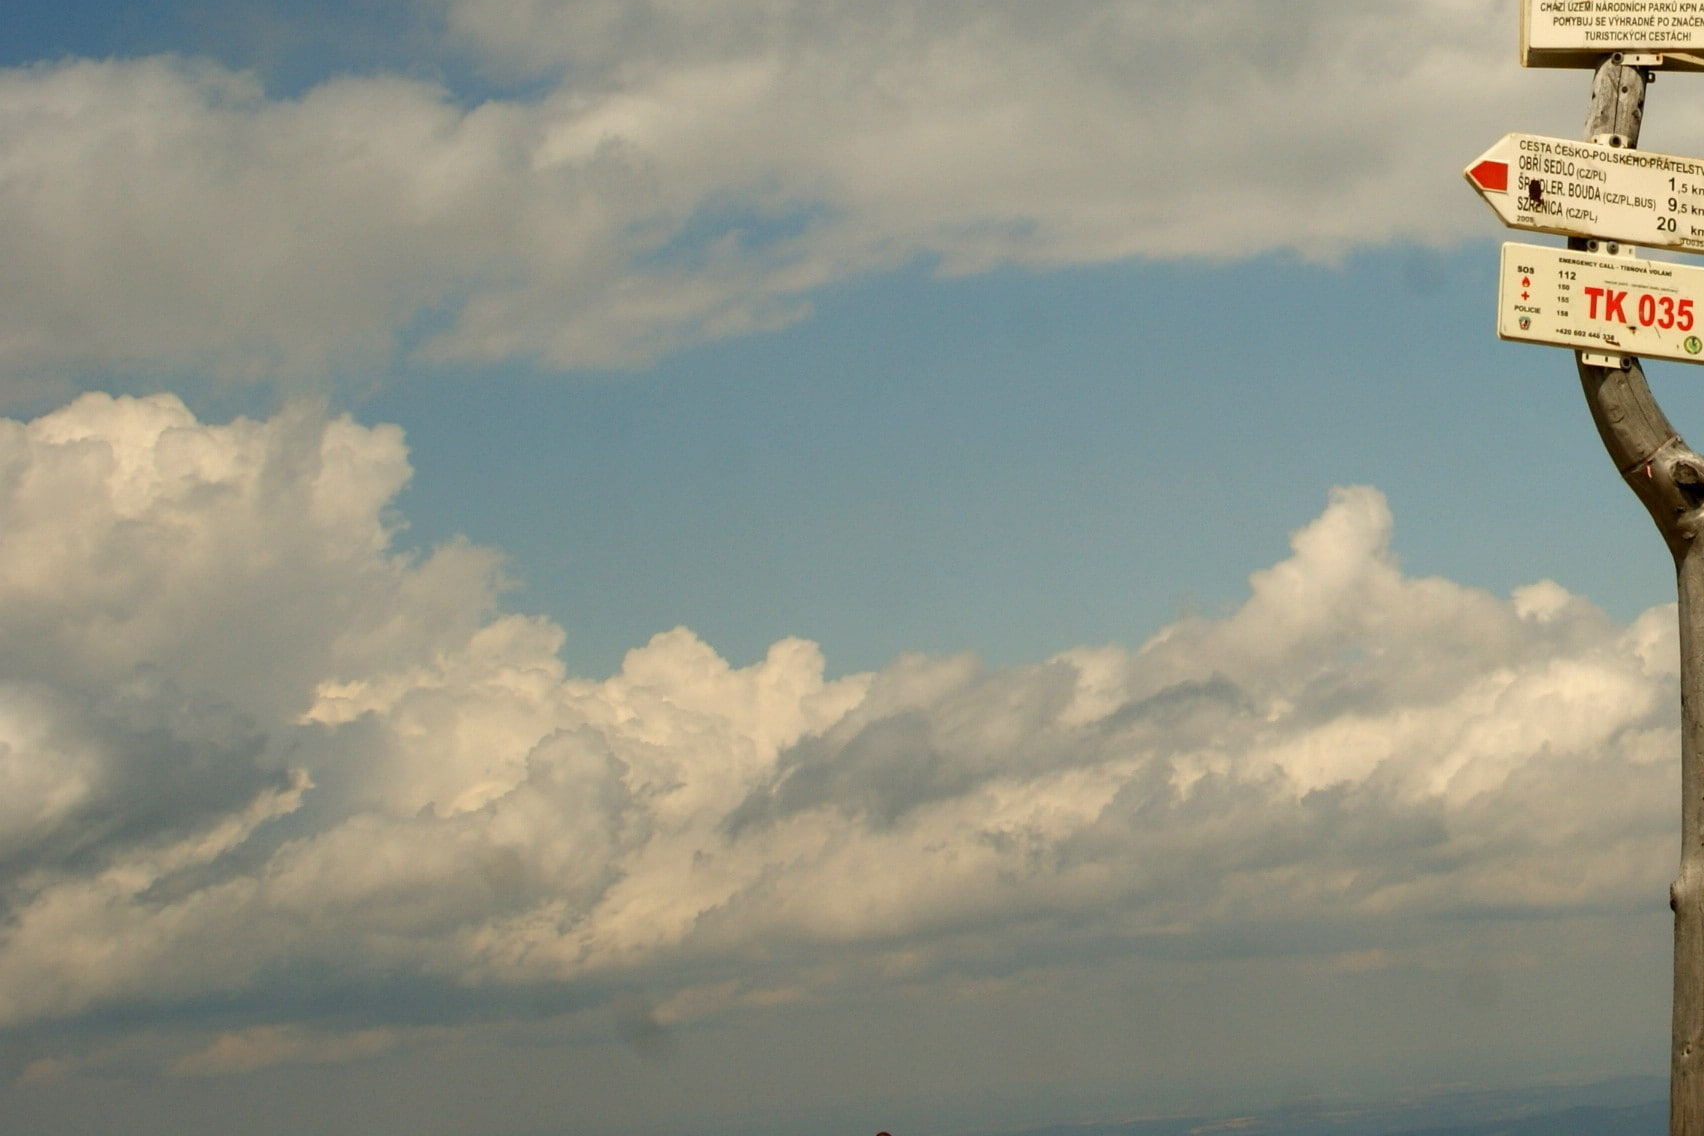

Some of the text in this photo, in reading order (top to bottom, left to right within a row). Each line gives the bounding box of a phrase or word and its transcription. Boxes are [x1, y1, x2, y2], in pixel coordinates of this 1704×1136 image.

[1540, 1, 1565, 12] CHÁZÍ
[1596, 1, 1646, 12] NÁRODNÍCH
[1649, 1, 1677, 12] PARKŮ
[1680, 3, 1697, 12] KPN
[1699, 3, 1704, 12] A
[1553, 16, 1593, 26] POHYBUJ
[1595, 17, 1606, 26] SE
[1608, 15, 1655, 27] VÝHRADNĚ
[1657, 17, 1669, 26] PO
[1585, 30, 1691, 41] TURISTICKÝCH CESTÁCH!
[1519, 140, 1552, 154] CESTA
[1554, 143, 1647, 167] ČESKO-POLSKÉHO
[1518, 153, 1541, 172] OBŘÍ
[1543, 159, 1575, 177] SEDLO
[1576, 168, 1607, 184] (CZ/PL)
[1668, 177, 1688, 194] 1,5
[1518, 172, 1565, 196] ŠPDLER.
[1568, 182, 1601, 202] BOUDA
[1667, 197, 1688, 214] 9,5
[1565, 207, 1598, 224] (CZ/PL)
[1656, 216, 1677, 232] 20
[1558, 257, 1597, 268] EMERGENCY
[1599, 262, 1615, 270] CALL
[1517, 265, 1534, 275] SOS
[1558, 270, 1576, 280] 112
[1514, 305, 1541, 314] POLICIE
[1584, 286, 1694, 332] TK 035
[1555, 328, 1572, 336] +420
